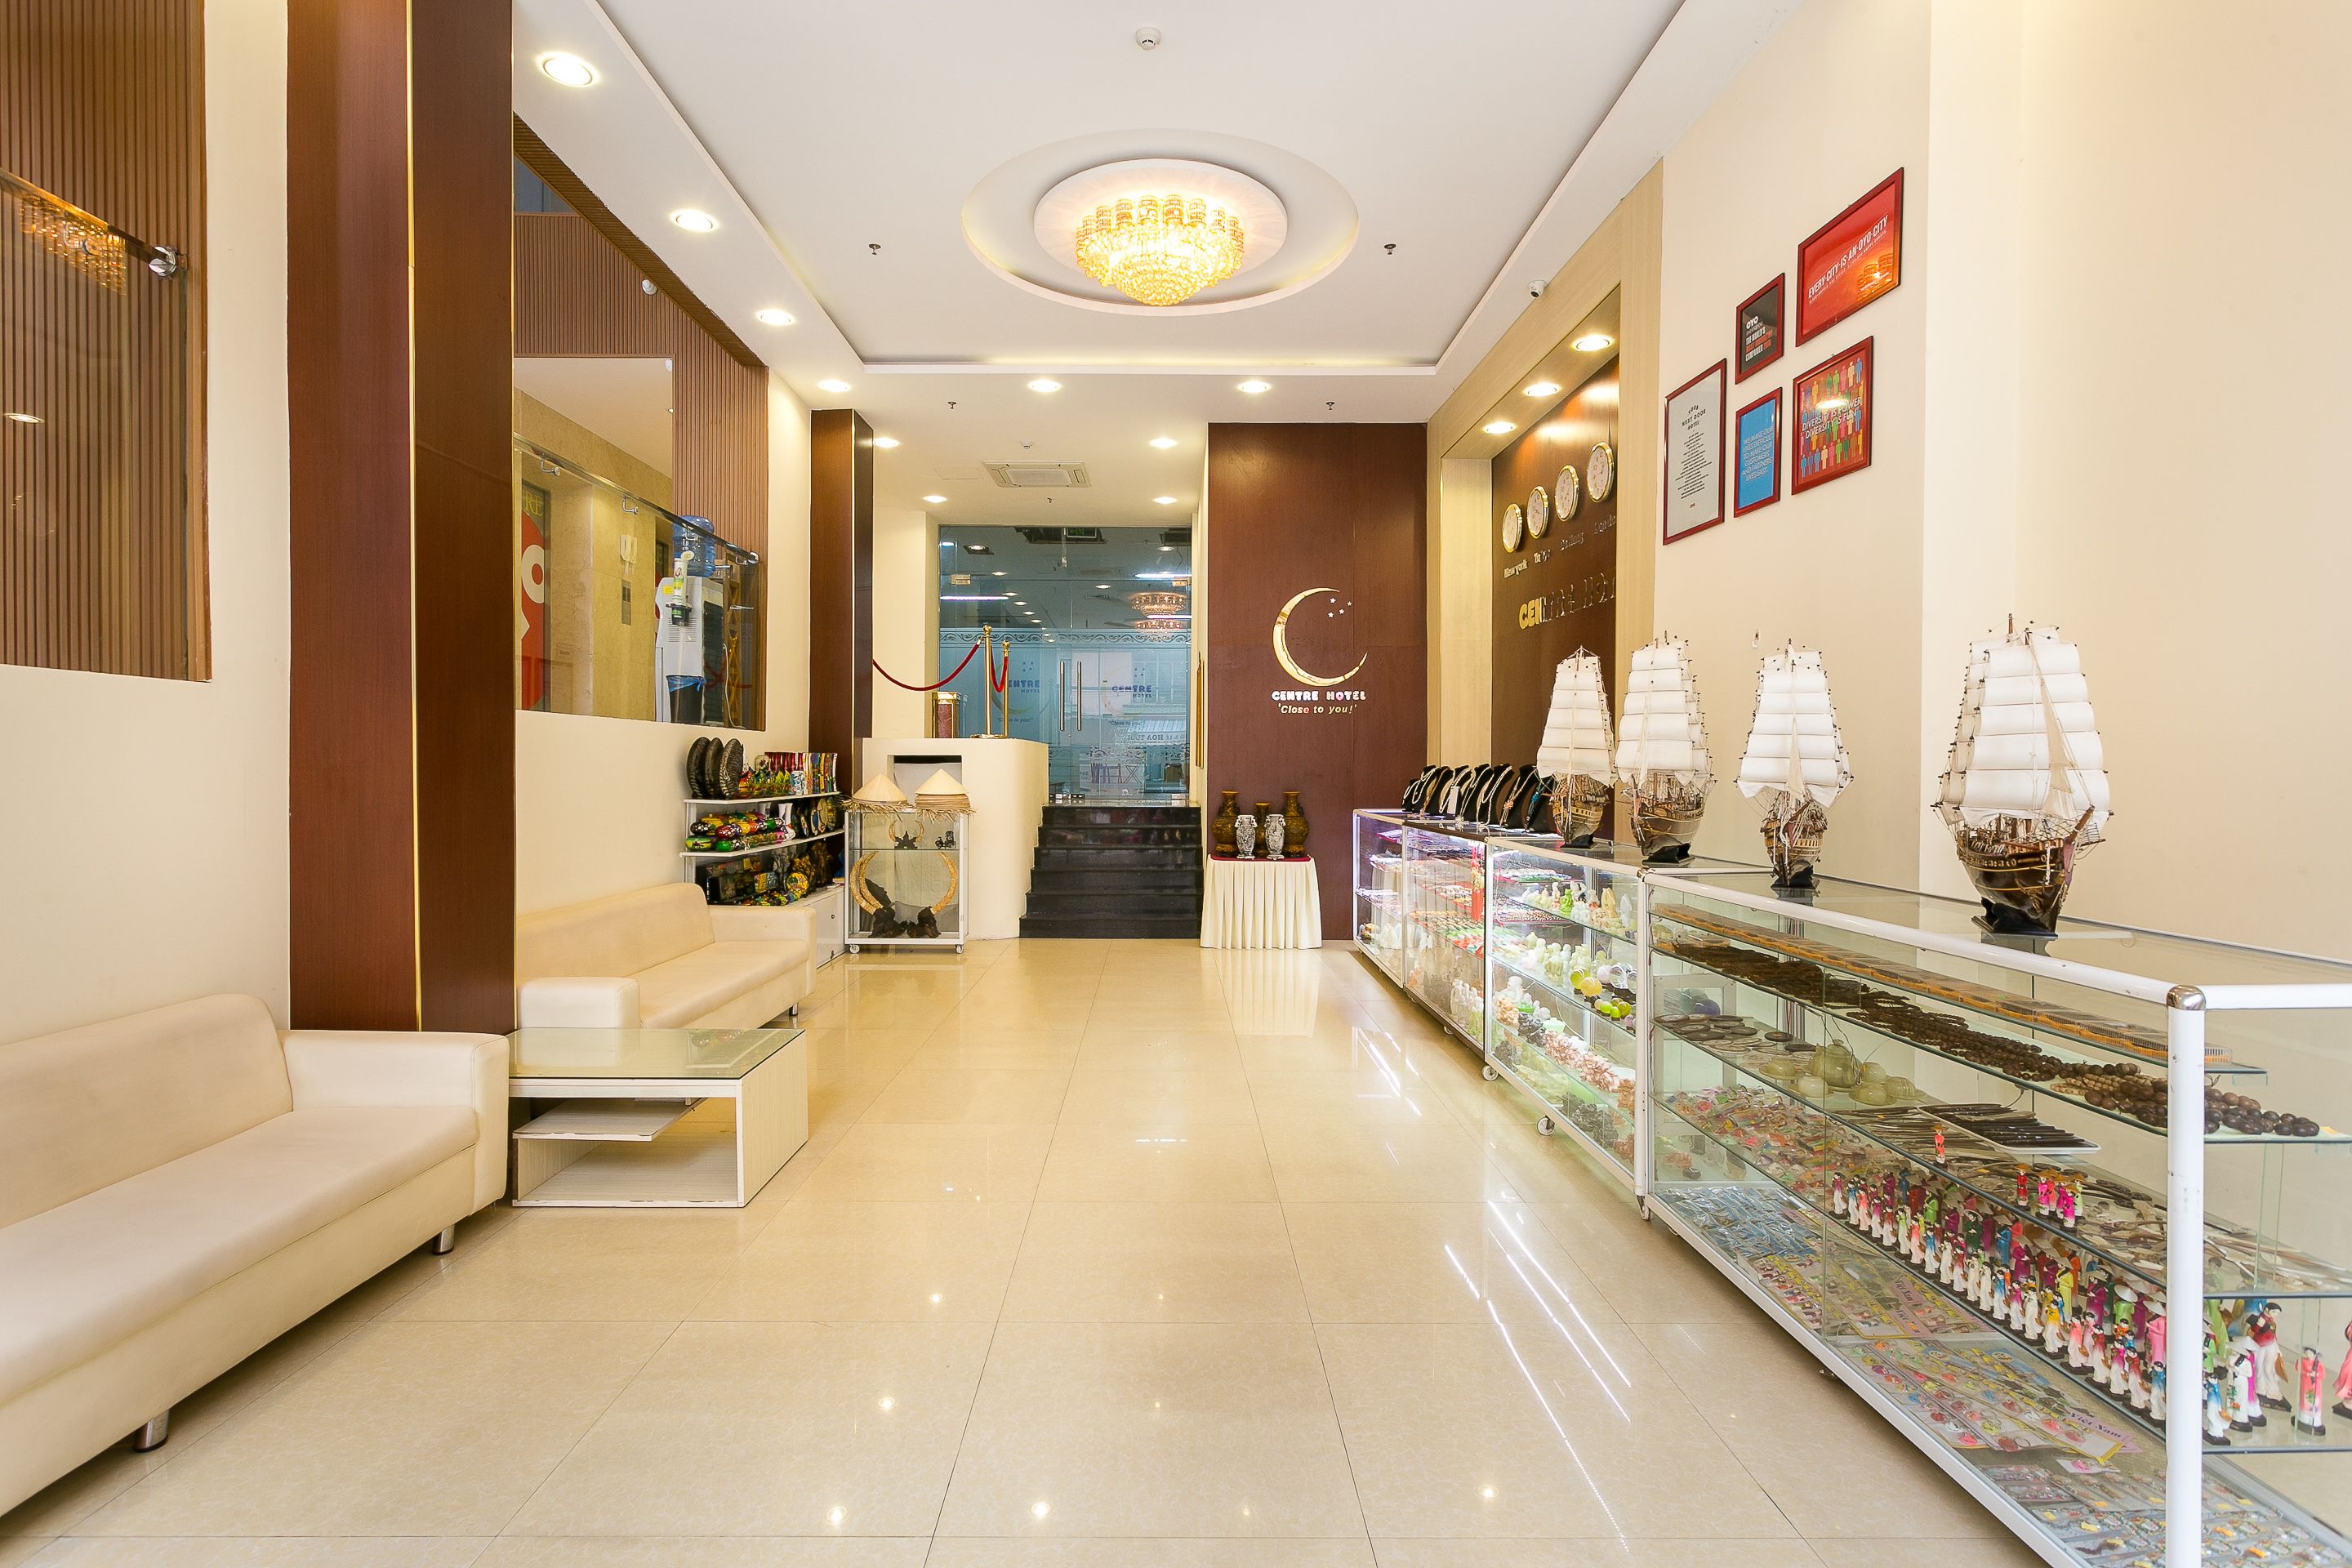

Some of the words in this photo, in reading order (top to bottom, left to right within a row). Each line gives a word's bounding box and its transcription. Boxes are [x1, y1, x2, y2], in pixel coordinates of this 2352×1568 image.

[1746, 315, 1758, 329] OYO
[1682, 416, 1692, 426] NEXT
[1694, 409, 1705, 419] DOOR
[1802, 410, 1831, 432] DIVERSITY
[1838, 398, 1862, 416] POWER
[1806, 420, 1834, 439] DIVERSITY
[1271, 690, 1319, 701] CENTRE
[1325, 690, 1366, 701] HOTEL
[1313, 705, 1325, 714] to
